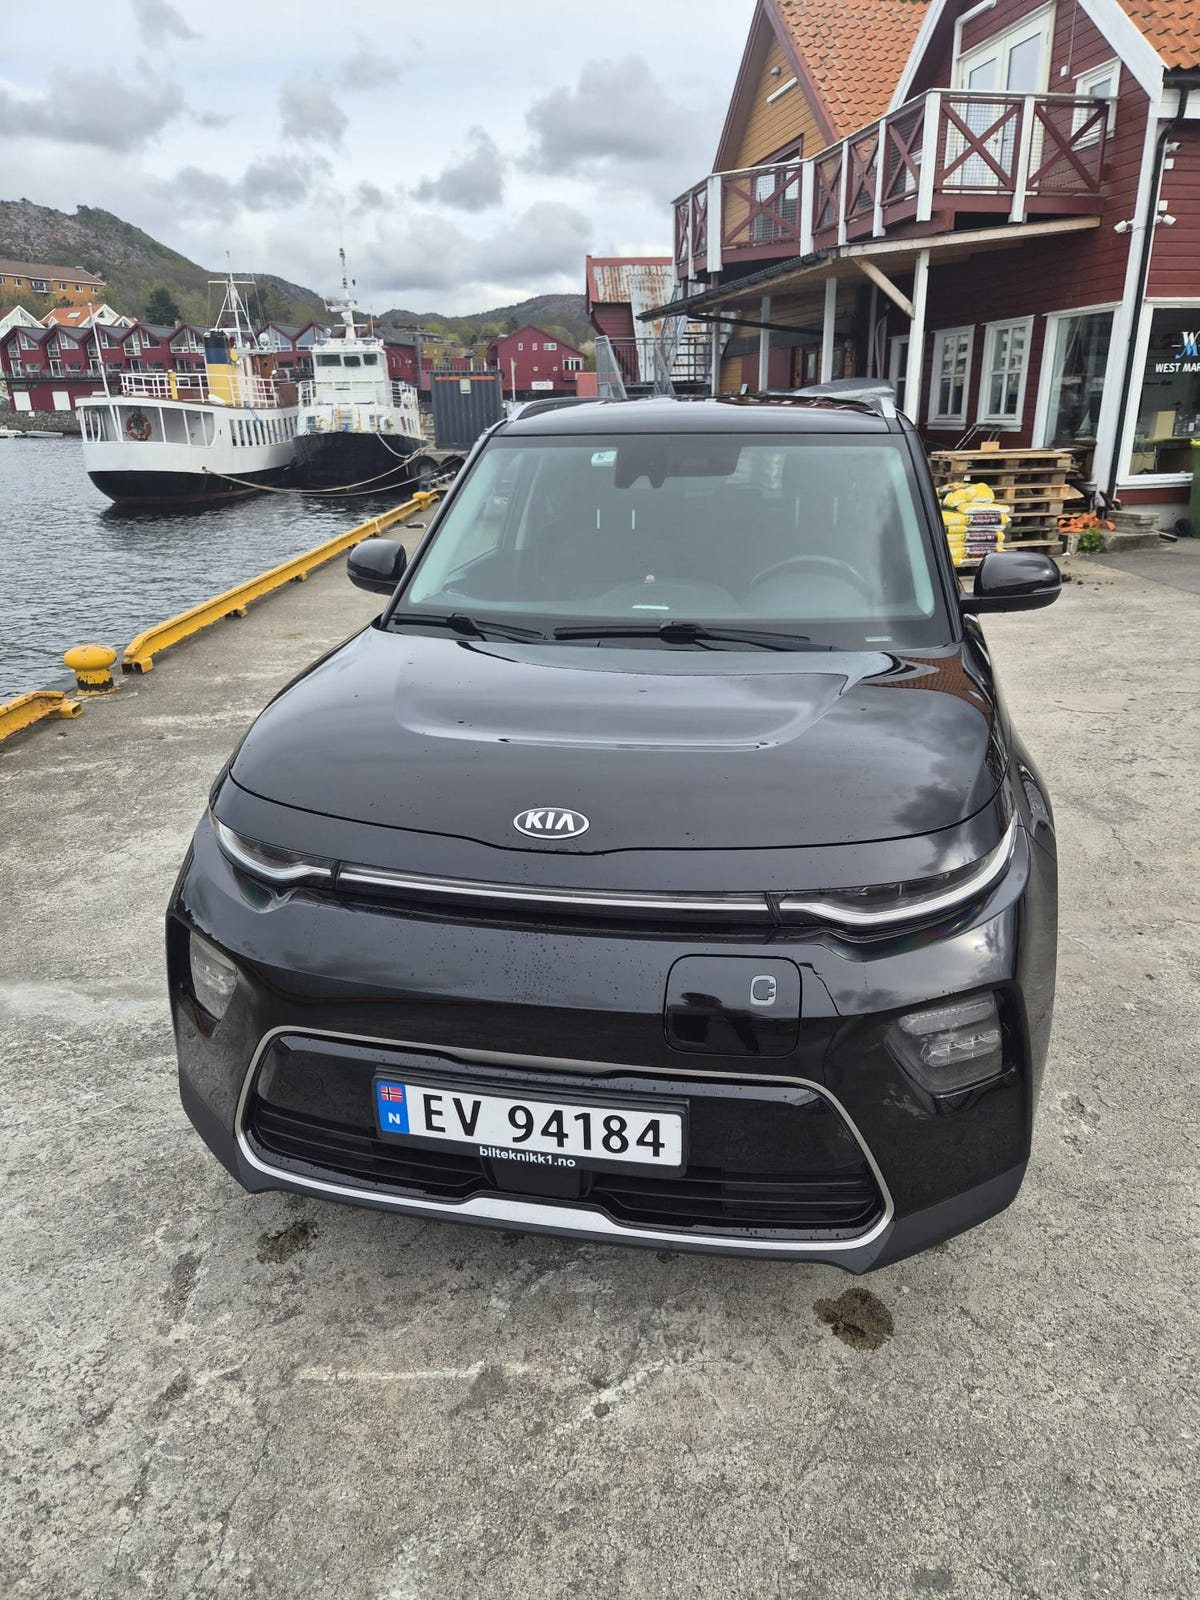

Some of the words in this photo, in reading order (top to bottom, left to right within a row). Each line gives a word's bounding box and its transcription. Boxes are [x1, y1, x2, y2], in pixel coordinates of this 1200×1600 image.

[1155, 362, 1182, 373] WEST
[525, 811, 575, 832] KIA
[387, 1112, 402, 1125] N
[422, 1093, 482, 1137] EV
[507, 1105, 666, 1158] 94184
[479, 1145, 577, 1168] bilteknikk1.no
